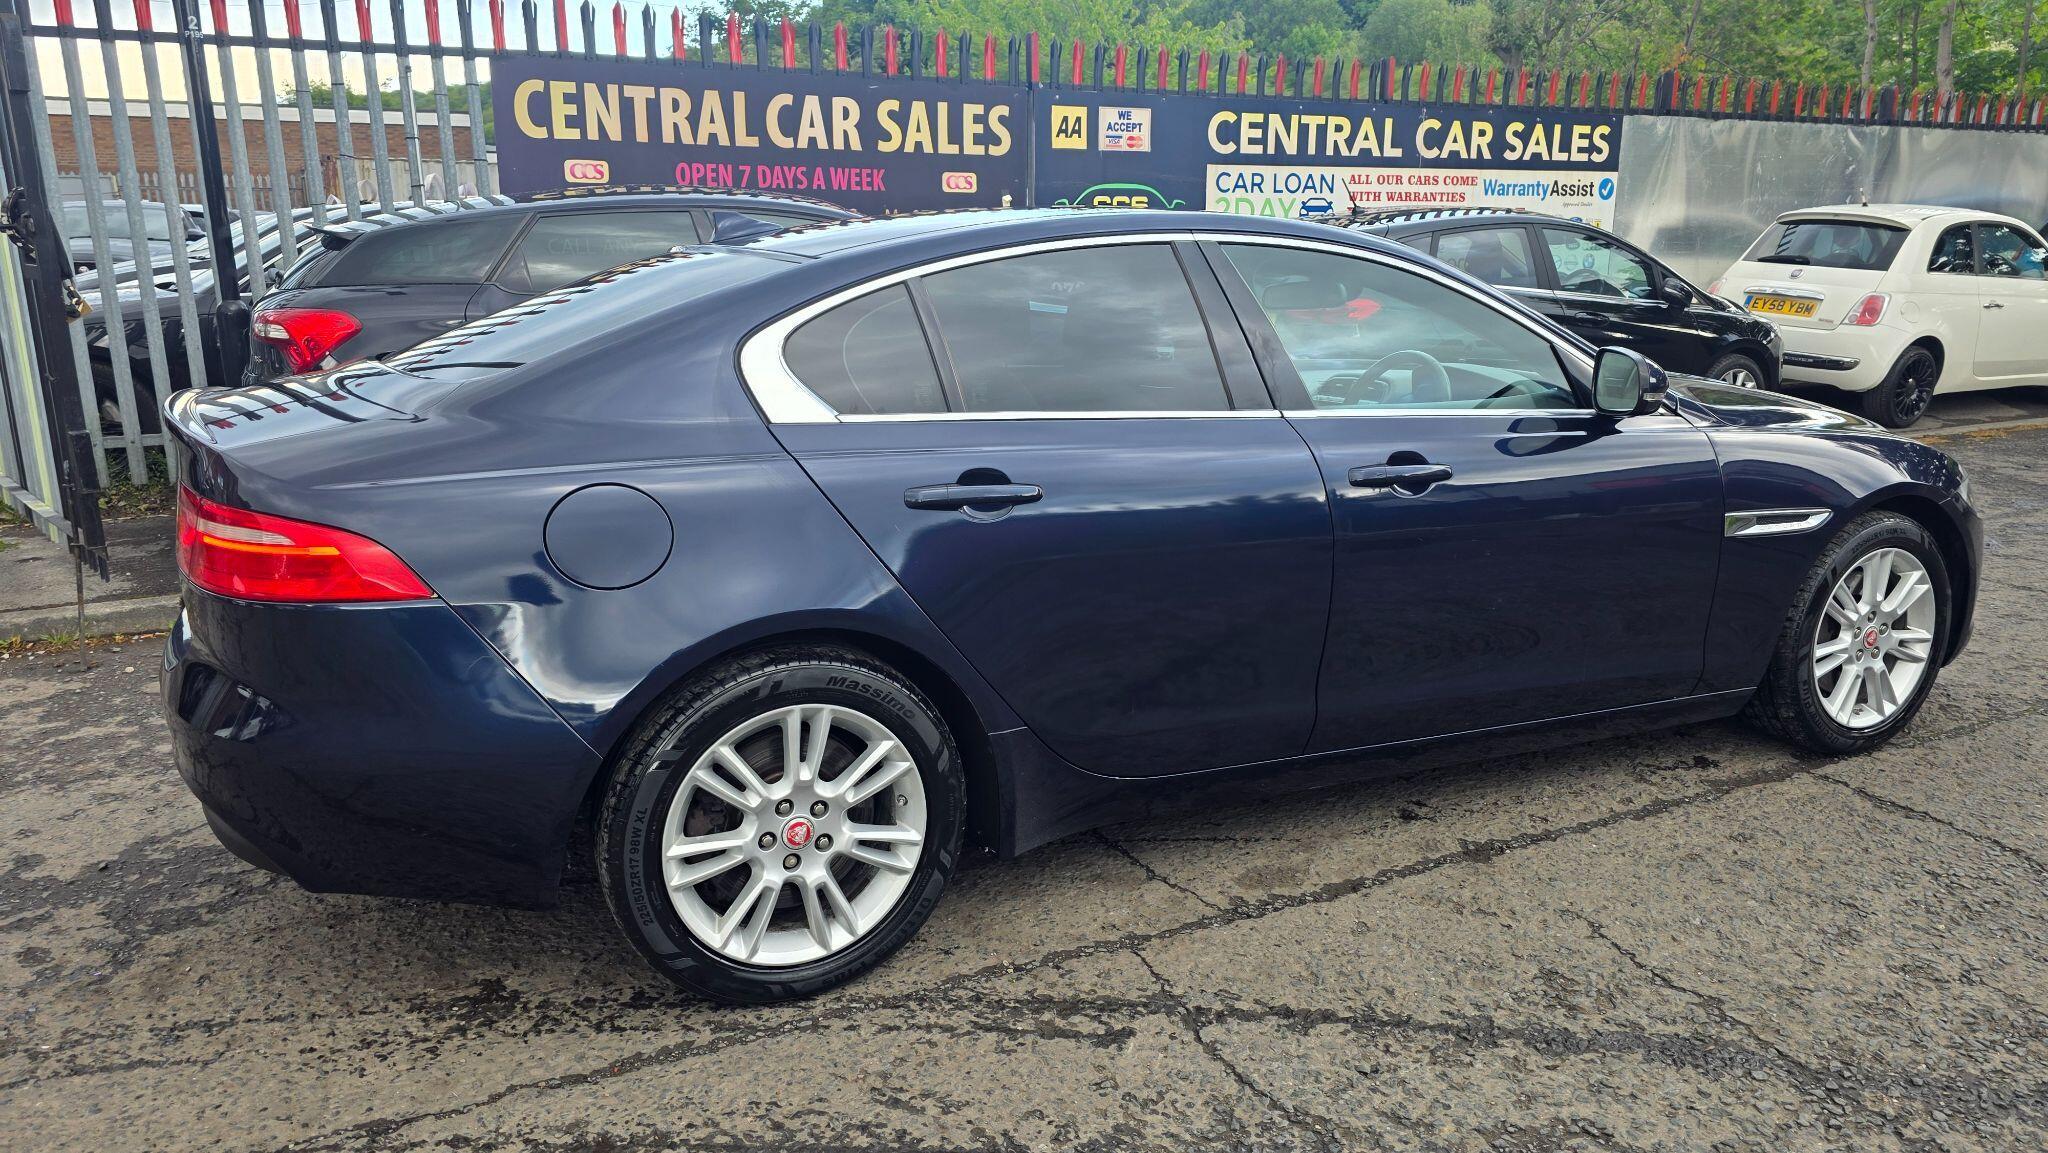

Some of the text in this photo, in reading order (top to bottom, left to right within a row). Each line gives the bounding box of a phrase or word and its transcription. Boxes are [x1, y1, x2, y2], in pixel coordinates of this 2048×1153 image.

[187, 15, 199, 30] 2
[513, 79, 1012, 156] CENTRAL CAR SALES
[1118, 110, 1132, 120] WE
[1056, 115, 1082, 139] AA
[1106, 122, 1143, 133] ACCEPT
[1207, 110, 1612, 163] CENTRAL CAR SALES
[569, 163, 605, 181] CCS
[676, 162, 887, 192] OPEN 7 DAYS A WEEK
[1348, 174, 1479, 187] ALL OUR CARS COME
[945, 173, 973, 190] CCS
[1215, 171, 1335, 195] CAR LOAN
[1349, 191, 1466, 203] WITH WARRANTIES
[1751, 297, 1815, 315] EY58 YBM
[825, 675, 916, 719] Massimo
[634, 806, 648, 824] XL
[629, 826, 642, 855] 98W
